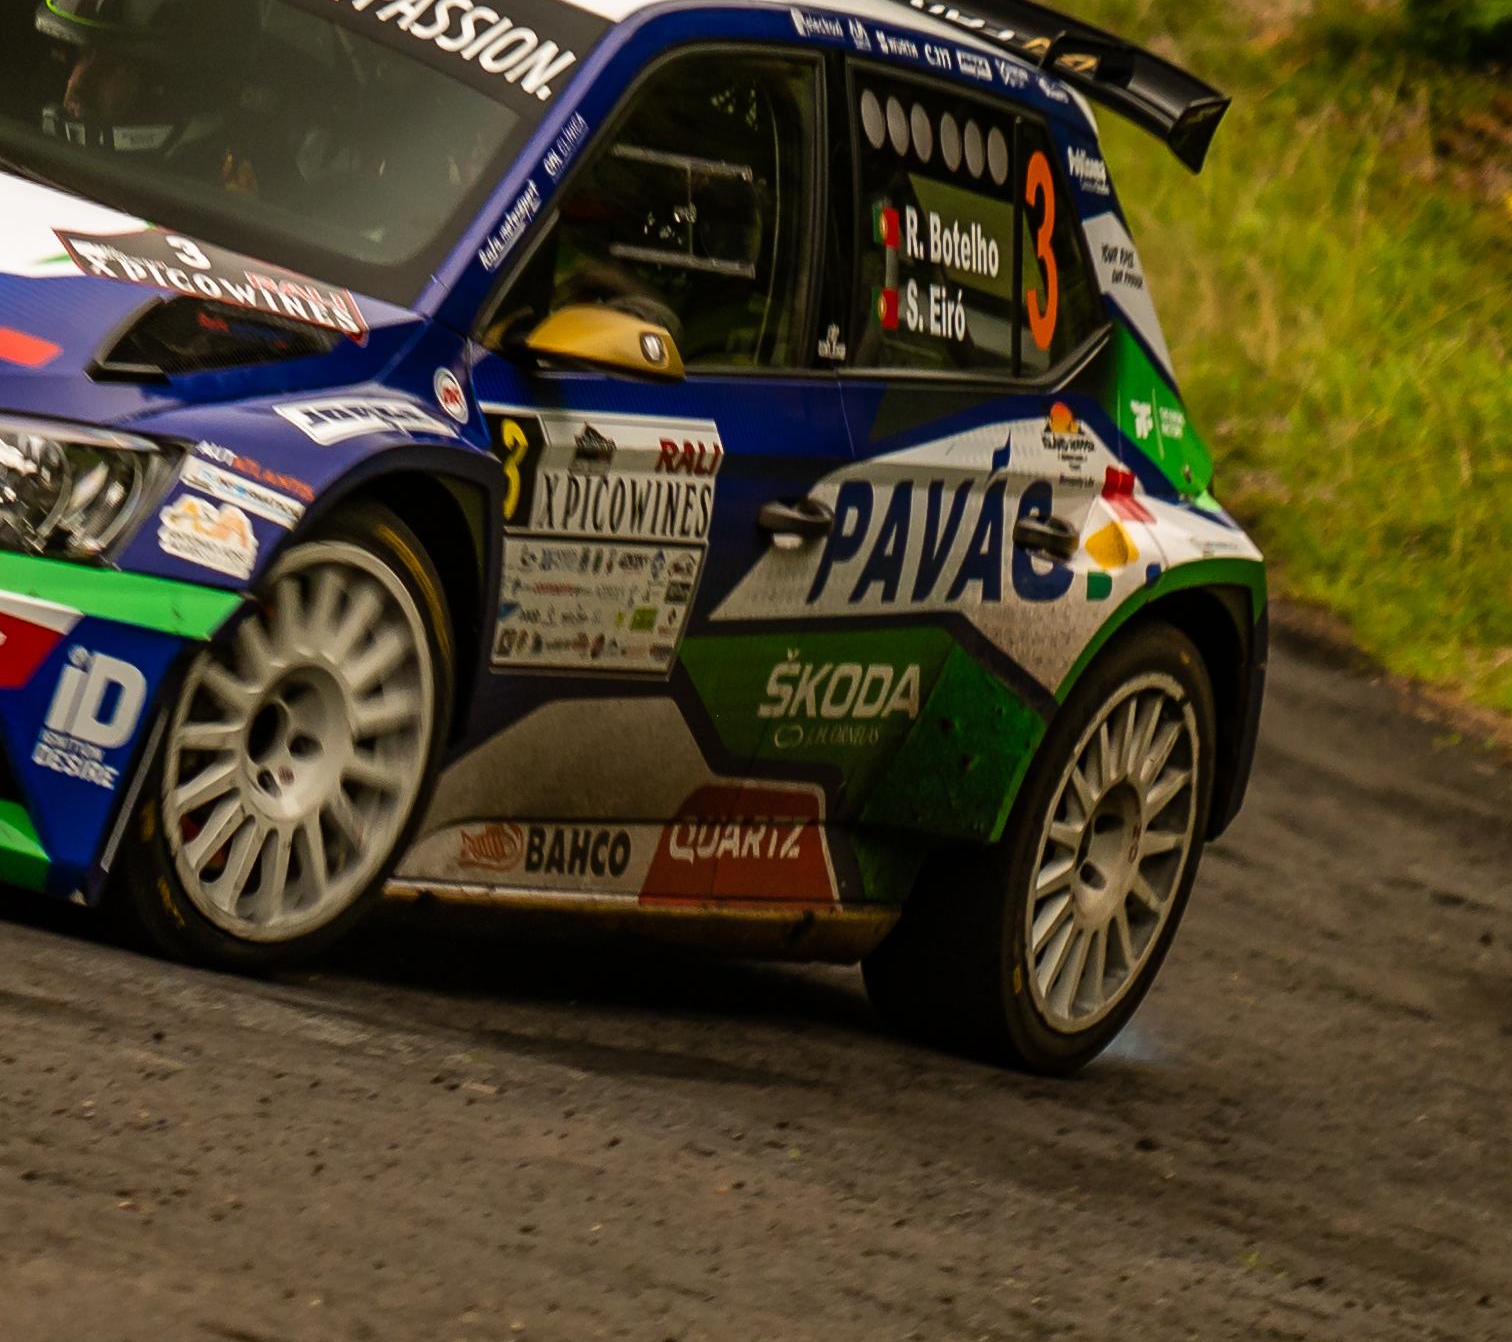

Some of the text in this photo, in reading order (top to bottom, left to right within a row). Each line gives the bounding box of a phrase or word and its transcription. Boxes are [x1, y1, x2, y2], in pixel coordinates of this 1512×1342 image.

[164, 234, 212, 270] 3
[905, 205, 1000, 278] R. Botelho
[1025, 151, 1059, 351] 3
[905, 278, 966, 342] S. Eiró
[562, 474, 713, 538] PICOWINES
[756, 647, 921, 720] ŠKODA
[524, 824, 632, 878] BAHCO
